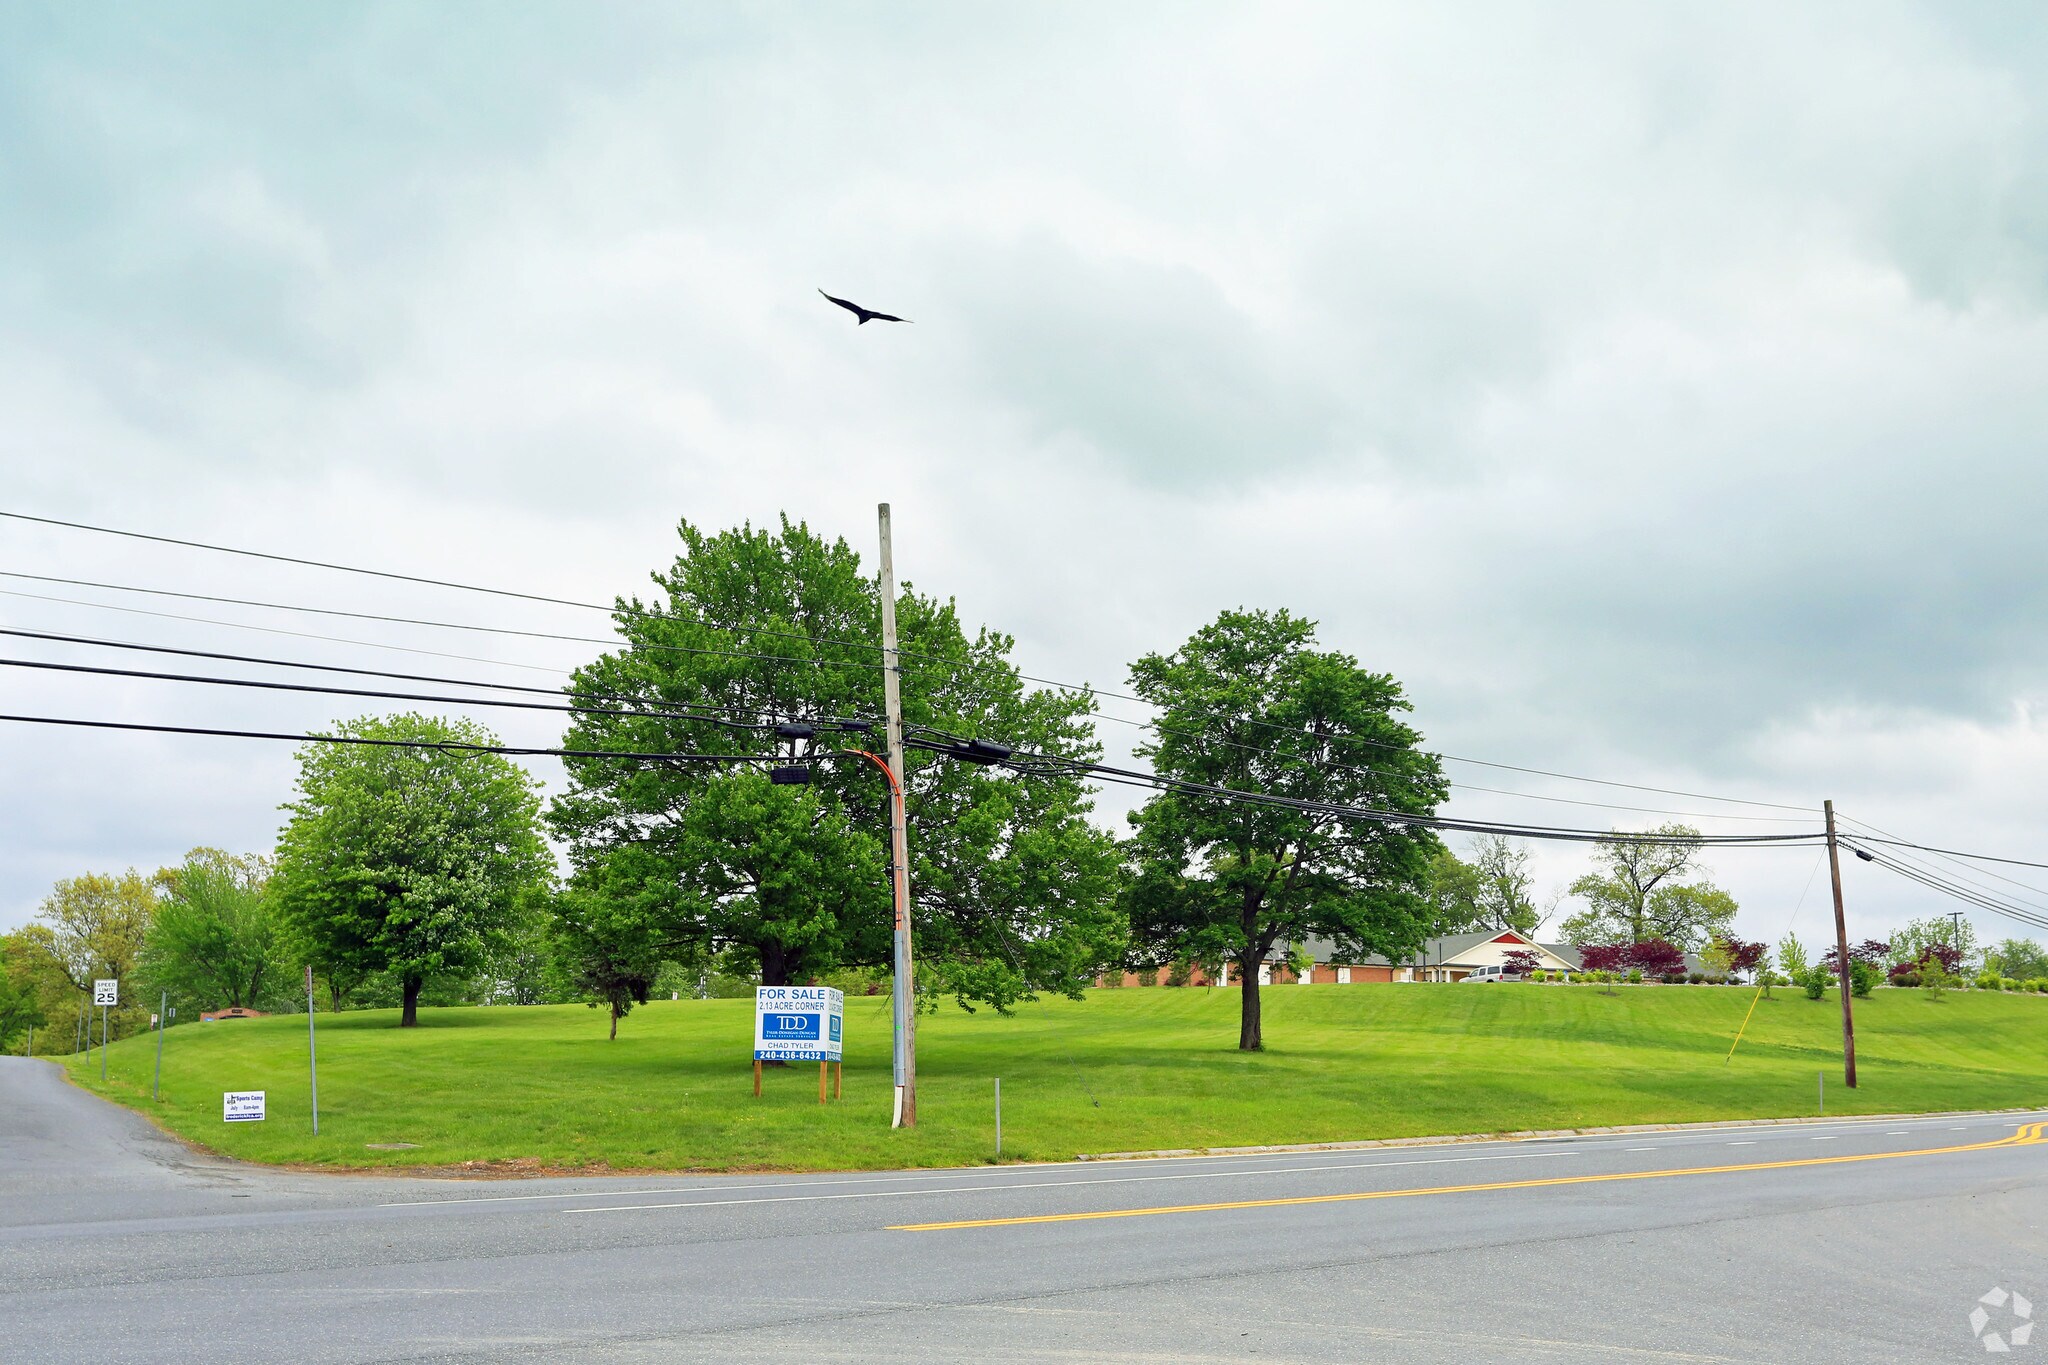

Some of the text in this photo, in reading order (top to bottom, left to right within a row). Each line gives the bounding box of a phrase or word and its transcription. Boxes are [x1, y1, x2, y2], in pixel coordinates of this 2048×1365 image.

[97, 993, 115, 1002] 25
[759, 989, 826, 1000] FOR SALE
[759, 1001, 773, 1010] 2.13
[774, 1001, 793, 1010] ACRE
[795, 1002, 825, 1011] CORNER
[776, 1015, 808, 1030] TDD
[760, 1051, 821, 1059] 240-436-6432
